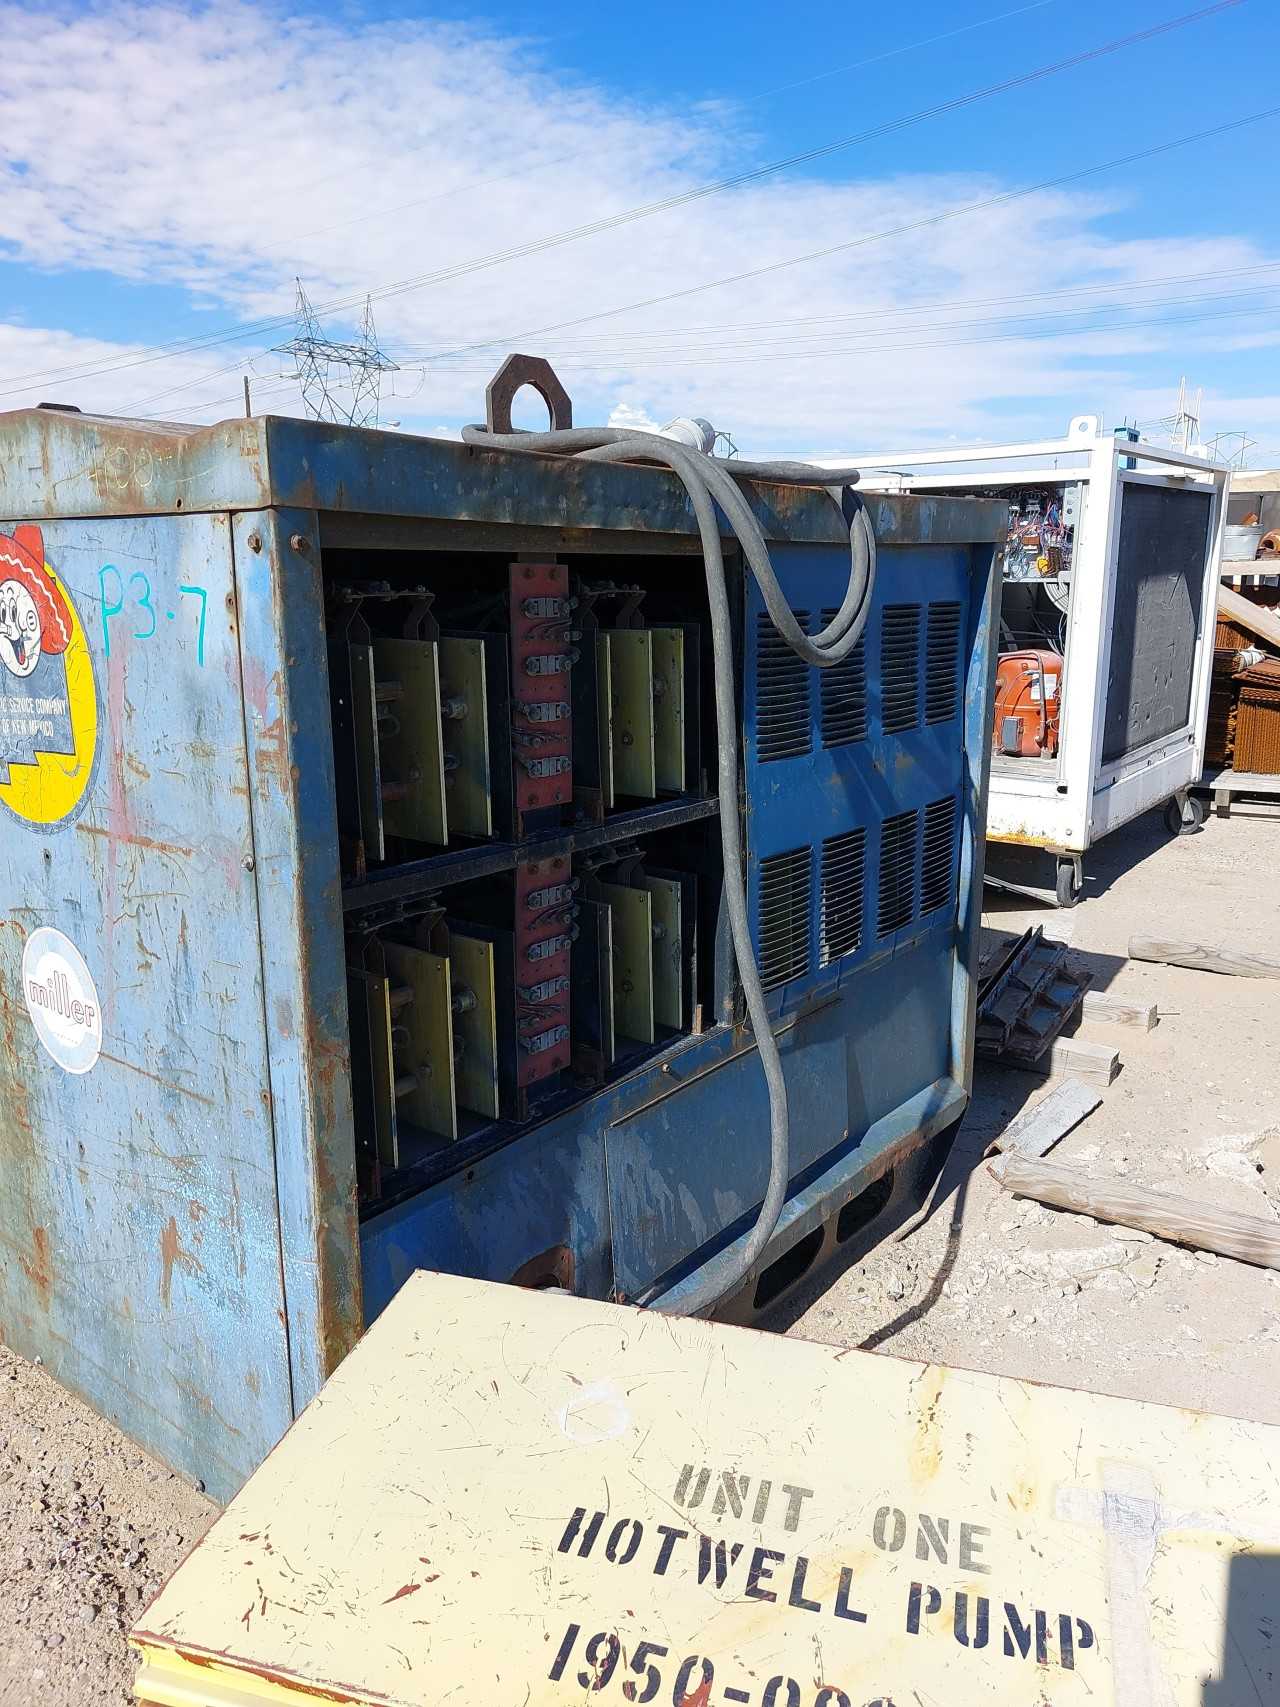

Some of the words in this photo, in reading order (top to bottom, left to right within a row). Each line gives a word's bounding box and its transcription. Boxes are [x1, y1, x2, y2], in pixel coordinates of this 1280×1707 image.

[35, 698, 66, 715] COMPANY
[29, 970, 95, 1027] miller
[673, 1463, 814, 1532] UNIT
[873, 1506, 993, 1575] ONE
[557, 1507, 868, 1623] HOTWELL
[905, 1582, 1095, 1670] PUMP
